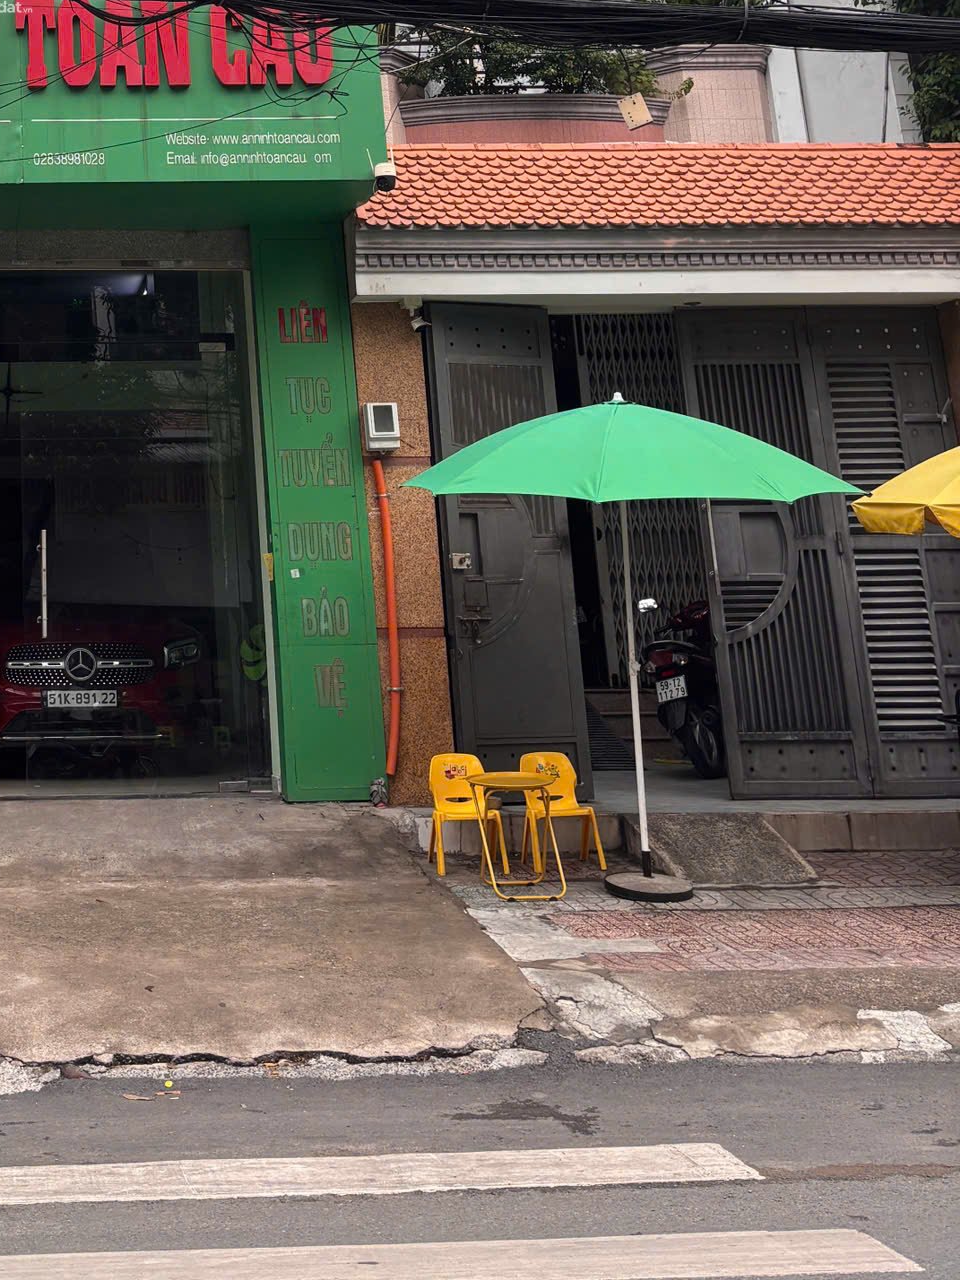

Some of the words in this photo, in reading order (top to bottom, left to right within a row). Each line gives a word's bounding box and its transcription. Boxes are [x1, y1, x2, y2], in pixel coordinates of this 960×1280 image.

[278, 299, 328, 344] LIÊN
[284, 376, 332, 422] TỤC
[277, 433, 352, 488] TUYỂN
[287, 521, 354, 569] DỤNG
[301, 586, 351, 638] BẢO
[49, 692, 116, 705] 51K-891.22
